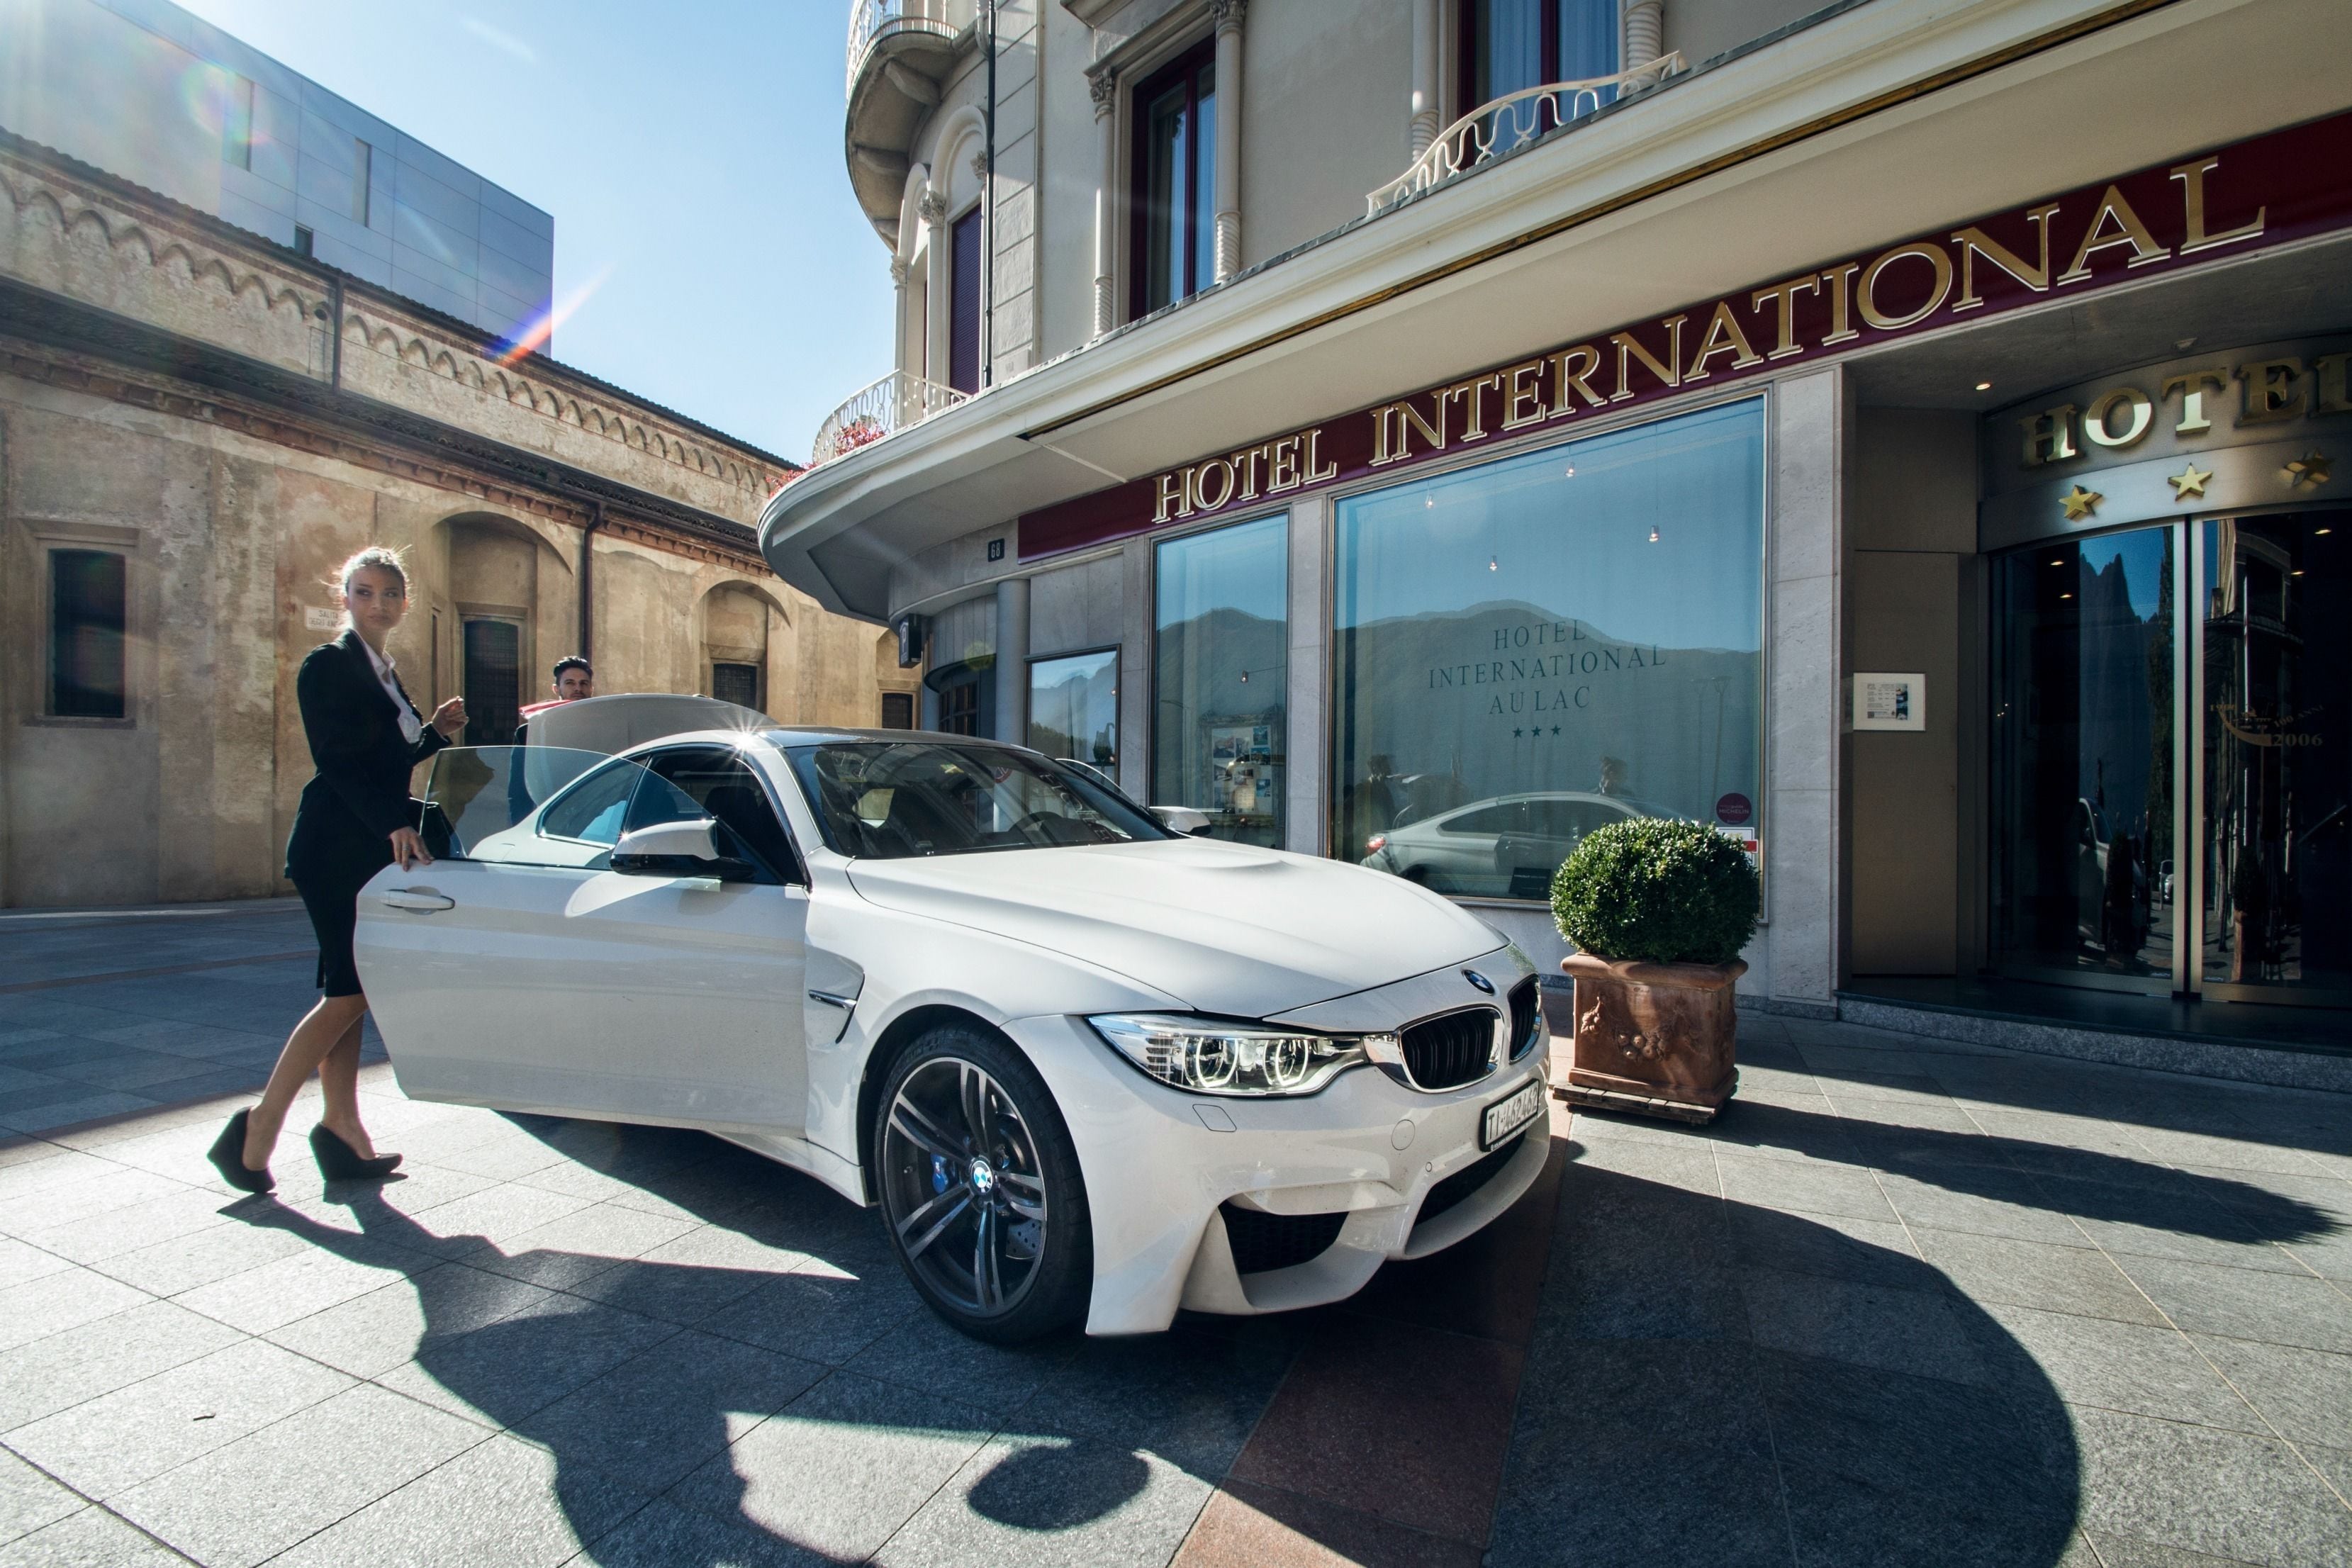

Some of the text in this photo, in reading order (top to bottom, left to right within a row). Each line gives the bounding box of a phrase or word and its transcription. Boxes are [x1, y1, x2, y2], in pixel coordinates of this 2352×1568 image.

[1151, 155, 2267, 525] HOTEL INTERNATIONAL
[991, 542, 1001, 559] 68
[1493, 619, 1586, 650] HOTEL
[1428, 643, 1667, 689] INTERNATIONAL
[2273, 715, 2295, 728] 100
[2273, 732, 2324, 746] 2006
